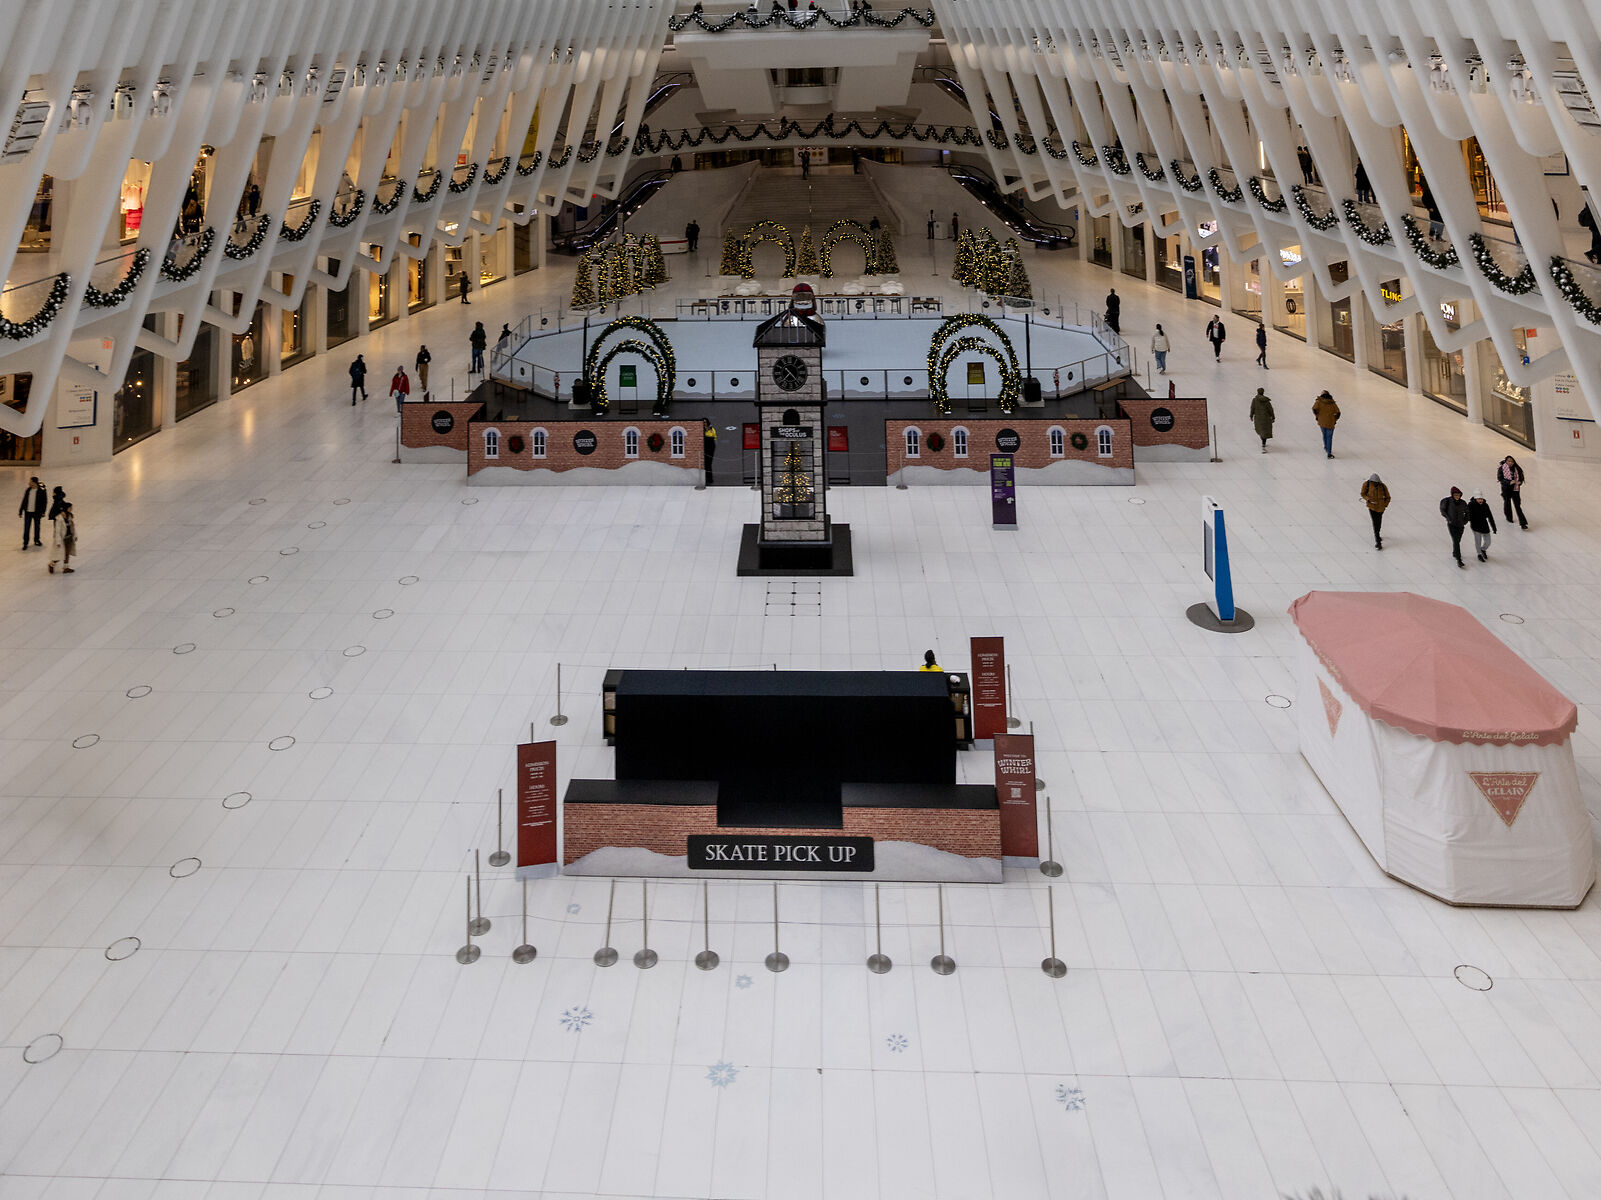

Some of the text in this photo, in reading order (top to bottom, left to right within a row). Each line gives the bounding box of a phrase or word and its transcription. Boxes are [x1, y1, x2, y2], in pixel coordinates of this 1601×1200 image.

[997, 758, 1032, 767] WINTER
[1000, 766, 1031, 774] WHIRL
[1487, 787, 1524, 796] GELATO
[705, 844, 857, 863] SKATE PICK UP
